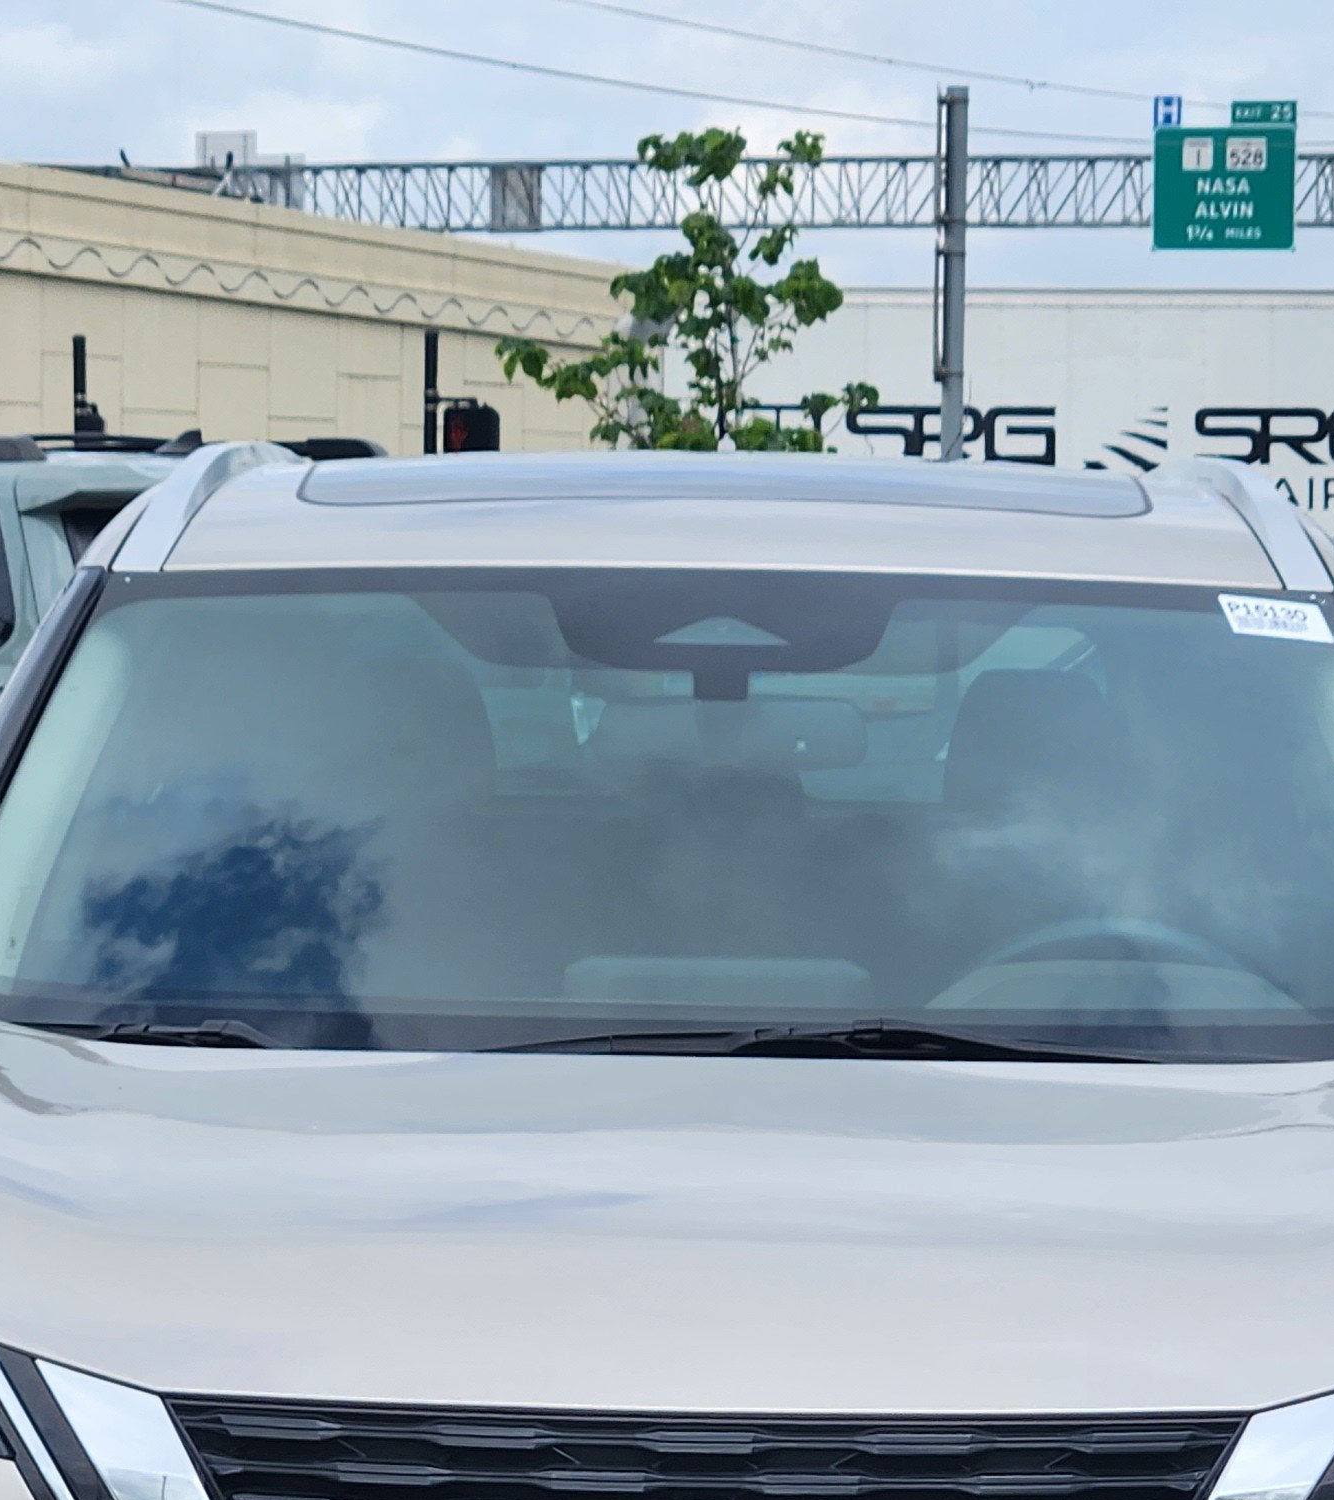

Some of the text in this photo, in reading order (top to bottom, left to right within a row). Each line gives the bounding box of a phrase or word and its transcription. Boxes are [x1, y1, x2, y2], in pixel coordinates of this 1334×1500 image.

[1234, 104, 1292, 120] EXIT 25
[1230, 149, 1264, 167] 528
[1197, 177, 1250, 195] NASA
[1195, 201, 1254, 219] ALVIN
[1225, 227, 1262, 239] MILES
